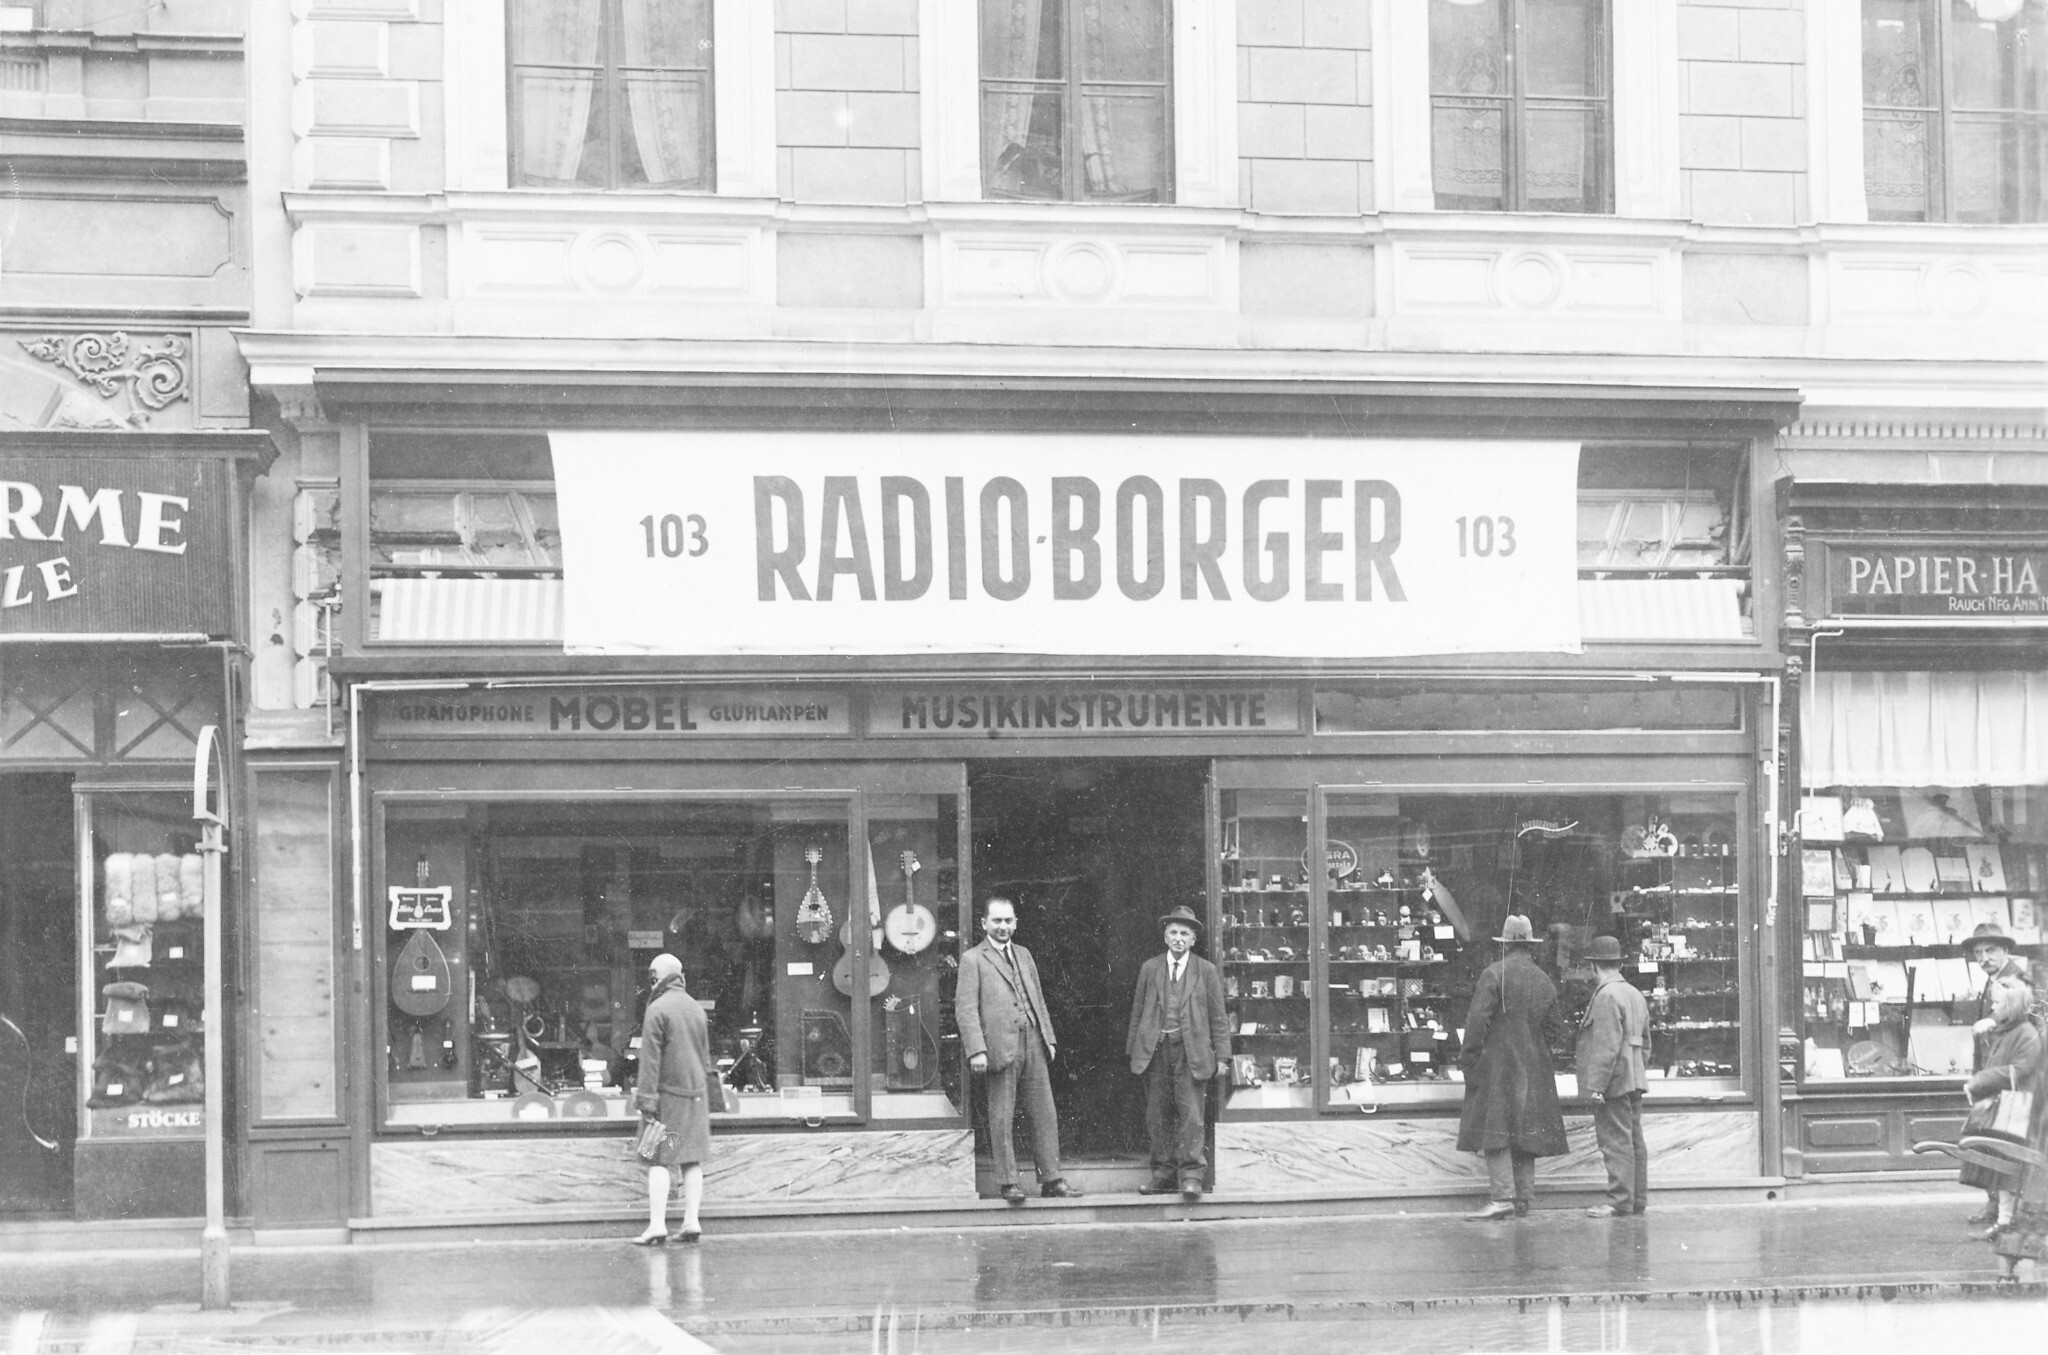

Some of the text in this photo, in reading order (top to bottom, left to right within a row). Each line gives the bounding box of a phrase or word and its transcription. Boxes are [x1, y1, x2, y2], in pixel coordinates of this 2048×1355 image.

[639, 513, 709, 558] 103
[1455, 515, 1517, 558] 103
[400, 705, 534, 721] GRAMOPHONE
[550, 695, 697, 731] MÖBEL
[902, 694, 1266, 730] MUSIKINSTRUMENTE
[128, 1110, 201, 1128] STÖCKE
